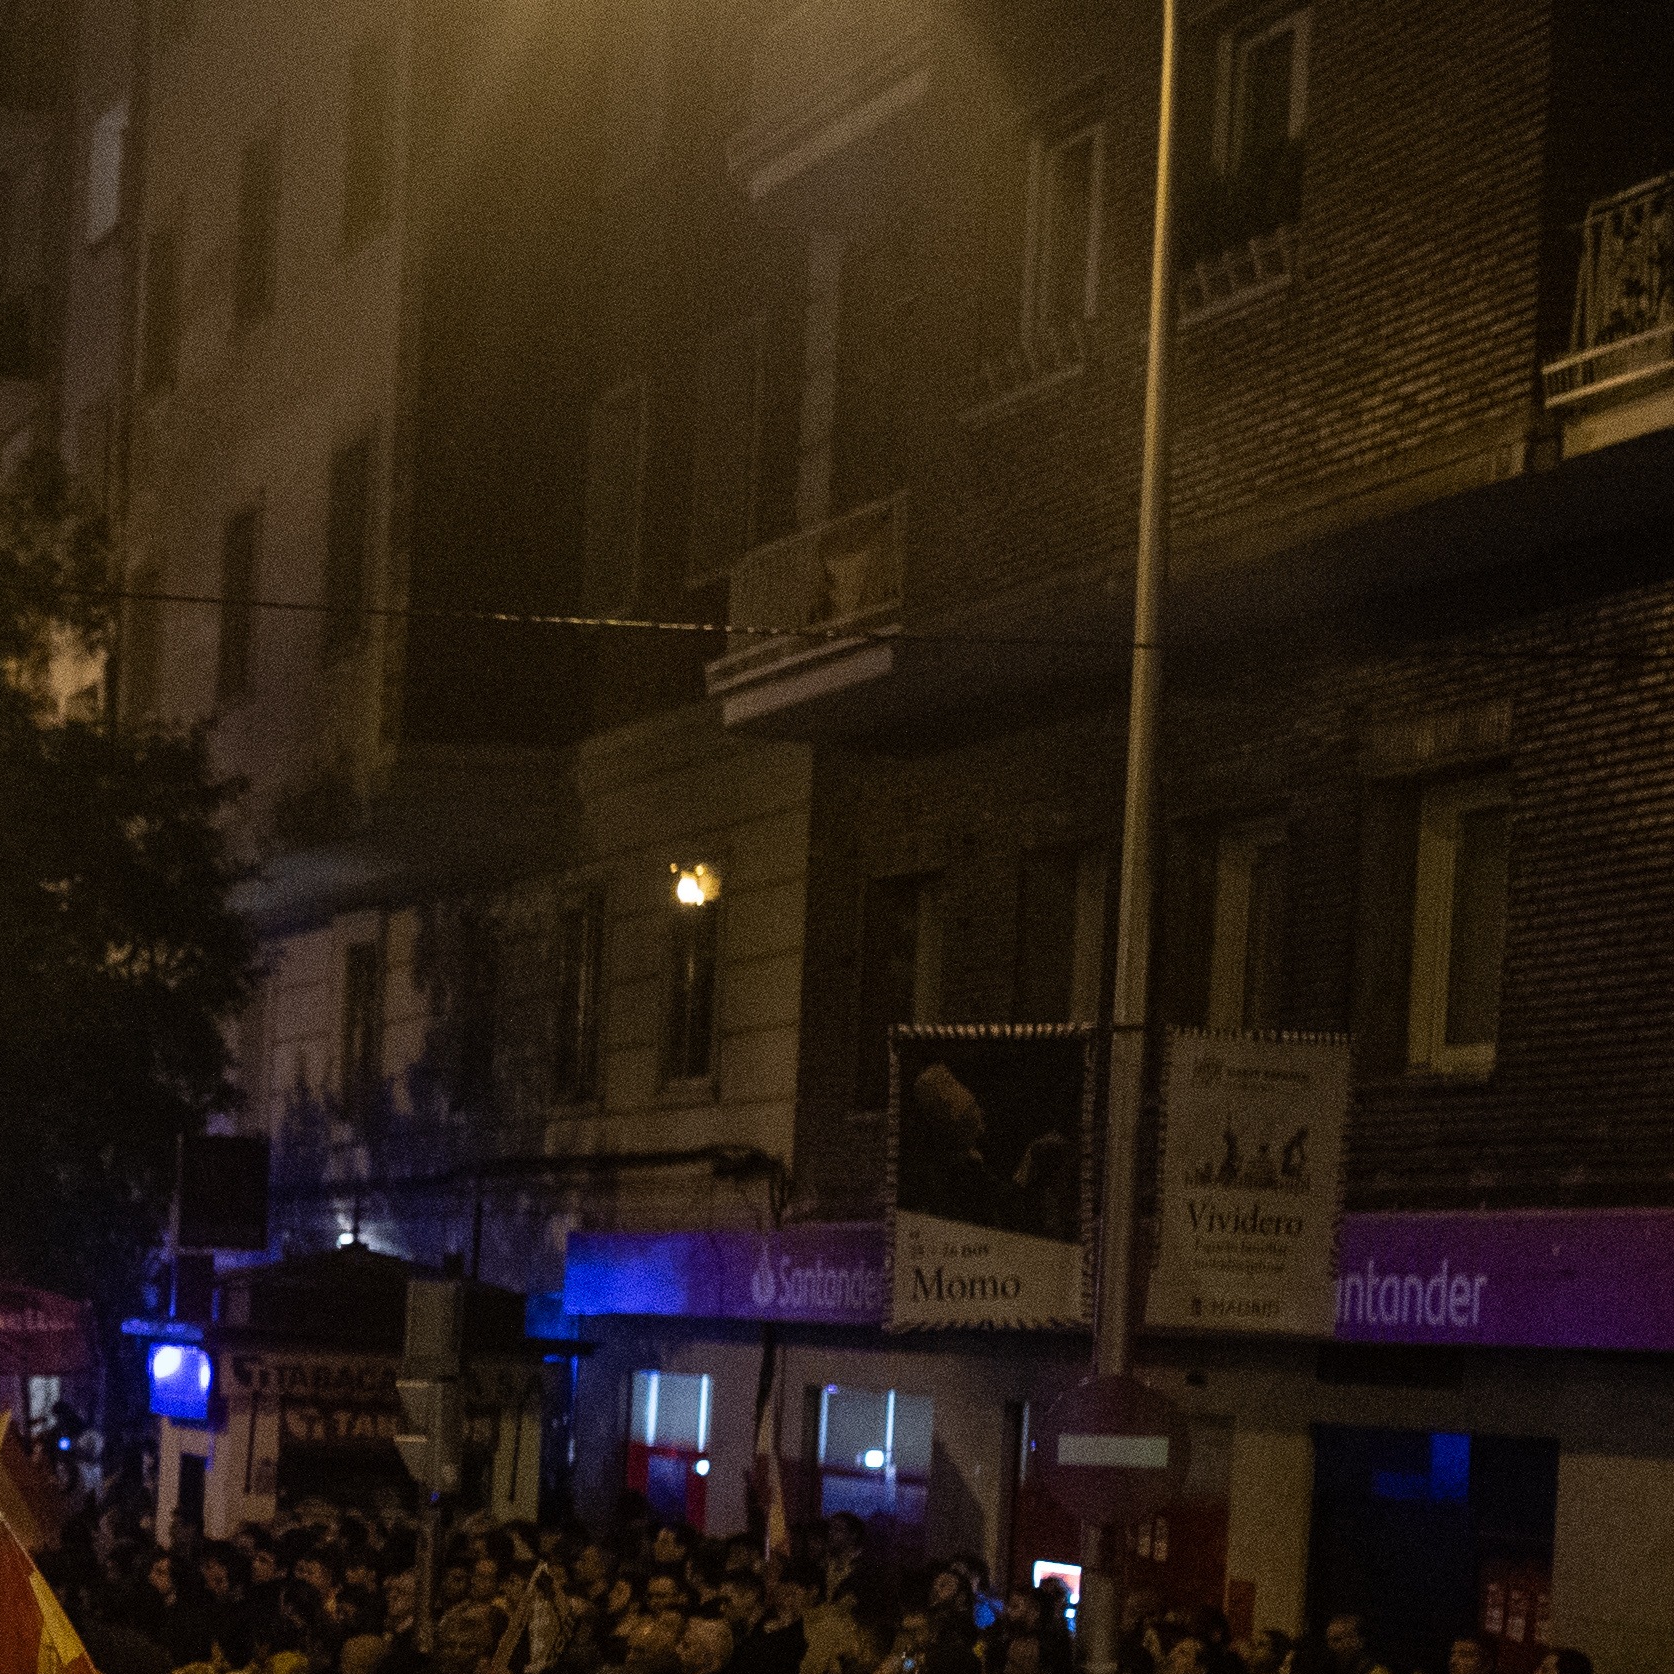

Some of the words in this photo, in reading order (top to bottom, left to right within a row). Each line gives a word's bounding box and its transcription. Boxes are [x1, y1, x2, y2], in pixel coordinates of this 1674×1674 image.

[1188, 1200, 1303, 1237] Vividero
[911, 1265, 1022, 1302] Momo
[1334, 1258, 1489, 1326] ntander
